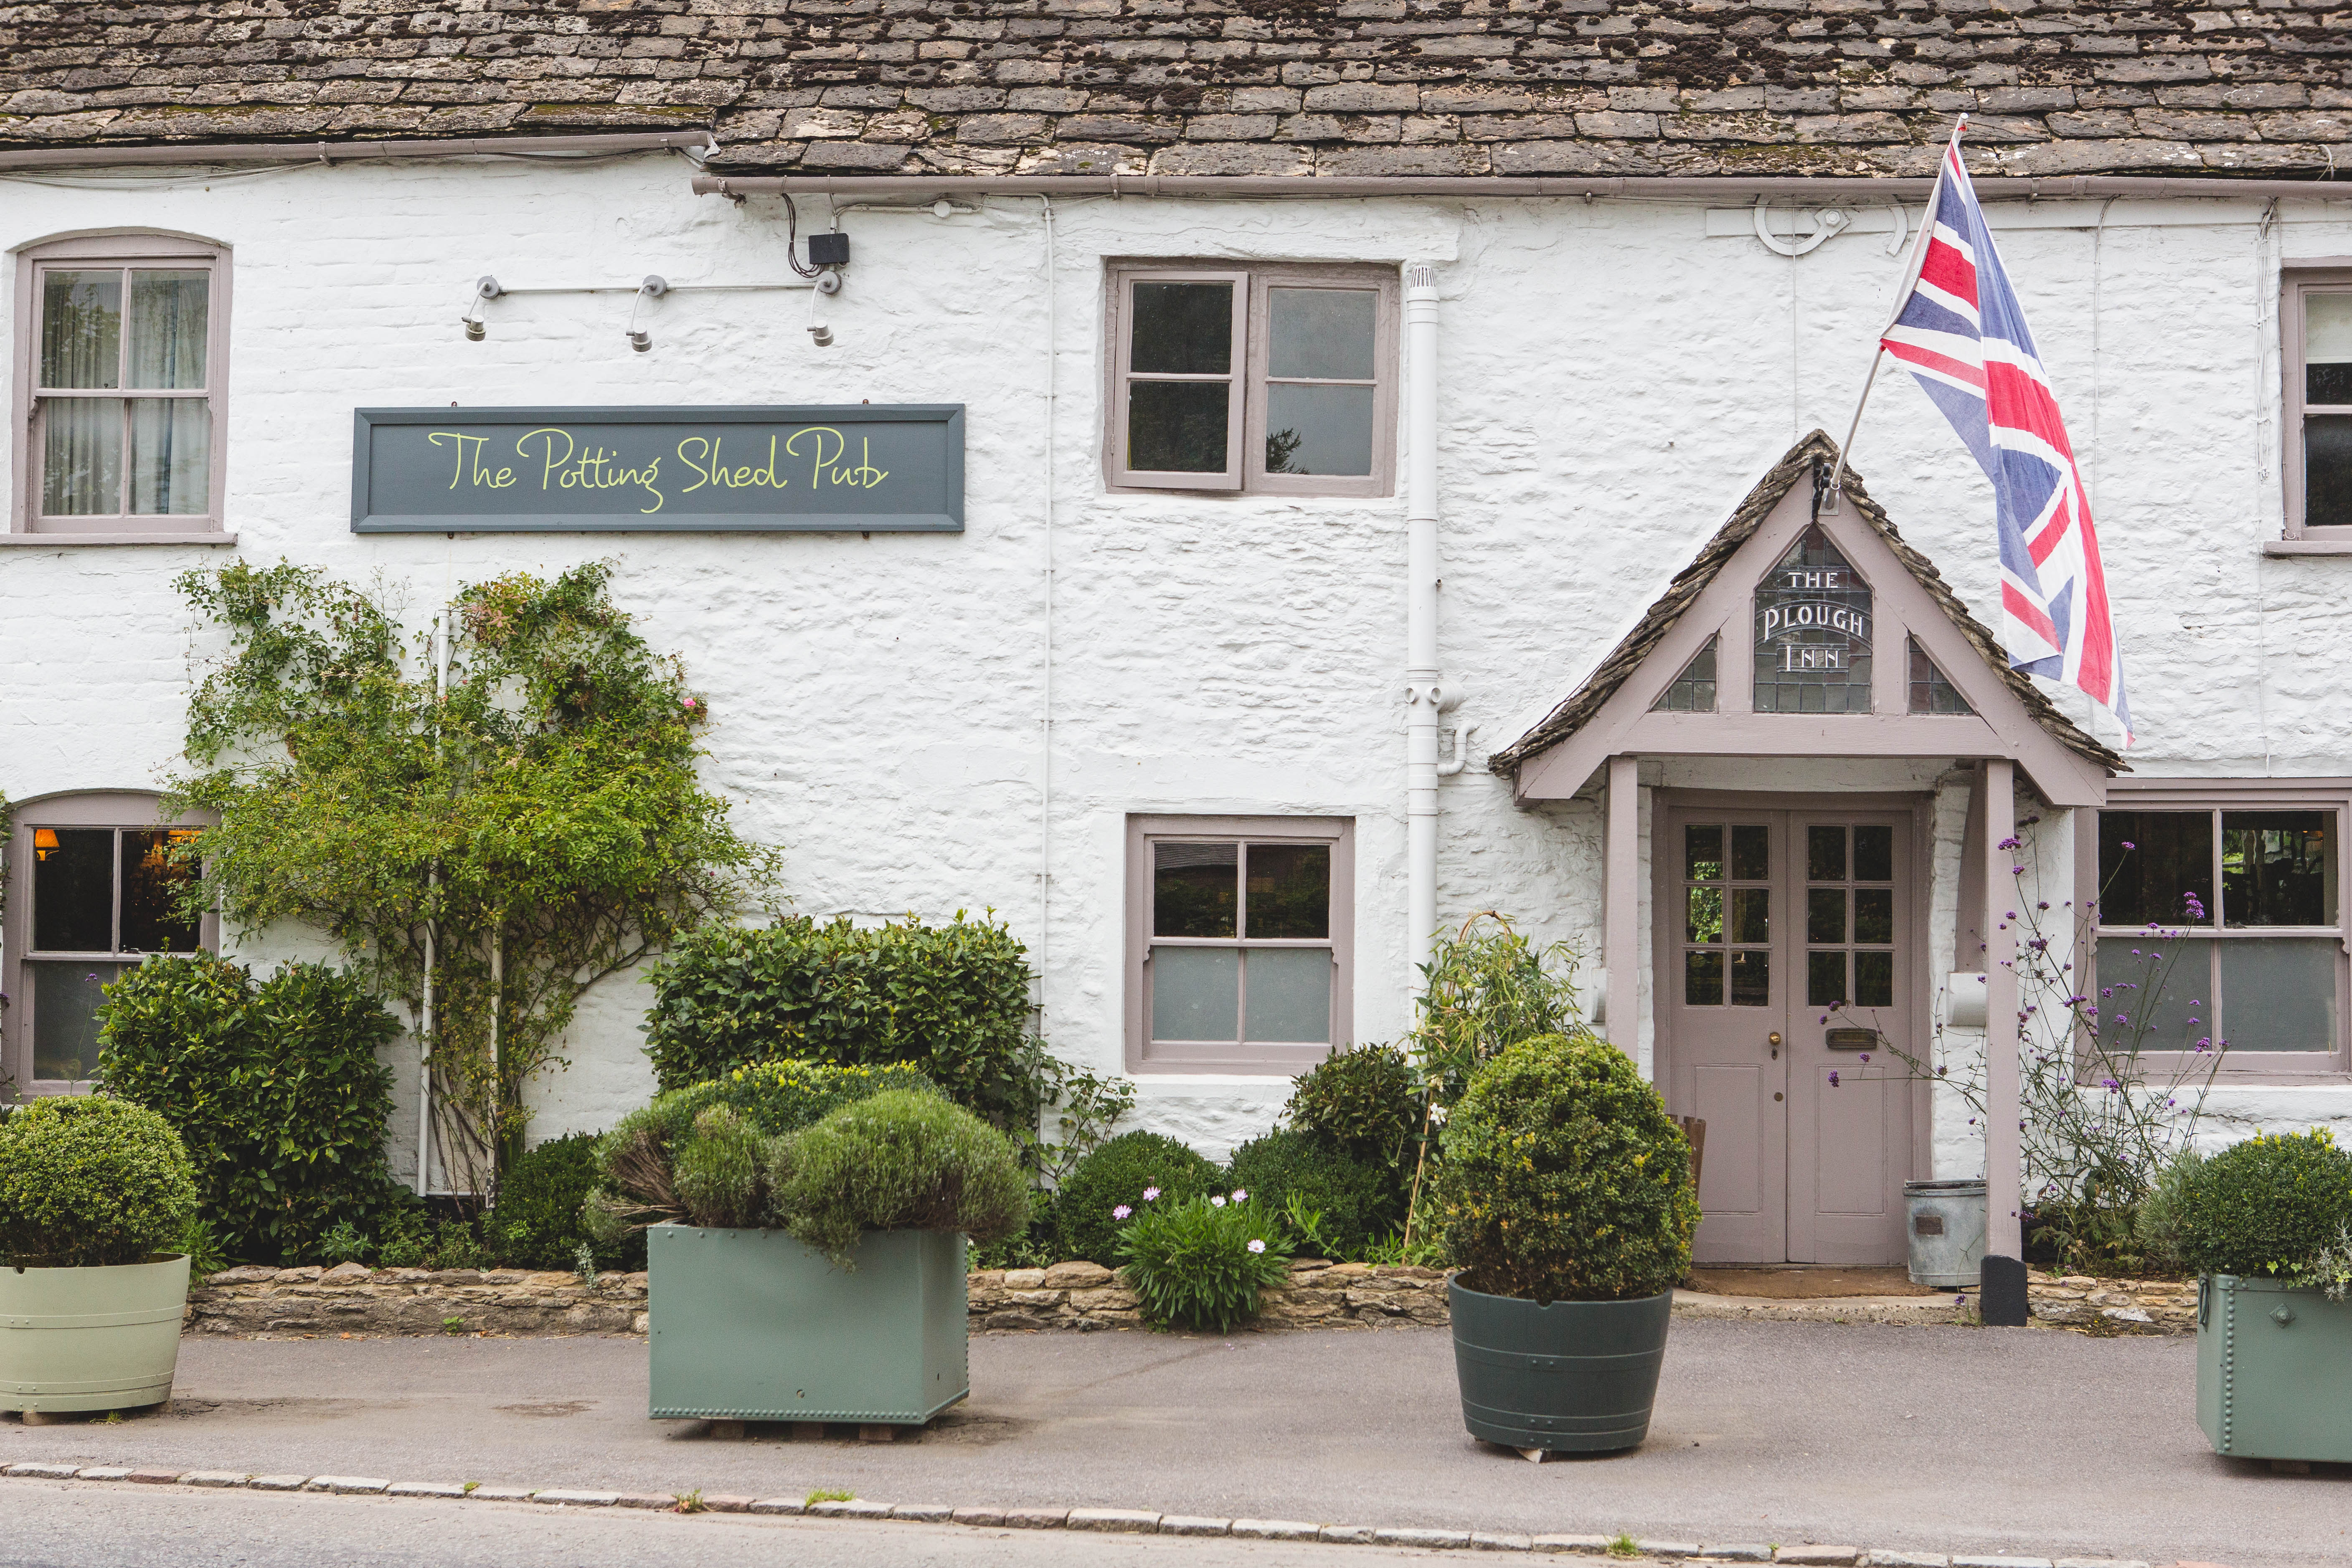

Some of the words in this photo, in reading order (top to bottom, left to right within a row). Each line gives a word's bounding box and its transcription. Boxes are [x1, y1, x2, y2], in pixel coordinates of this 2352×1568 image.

[429, 432, 517, 490] The
[517, 428, 663, 513] Potting
[677, 435, 788, 493] Shed
[786, 426, 889, 489] Pub
[1788, 572, 1838, 588] THE
[1764, 606, 1863, 641] PLOUGH
[1786, 645, 1839, 672] INN
